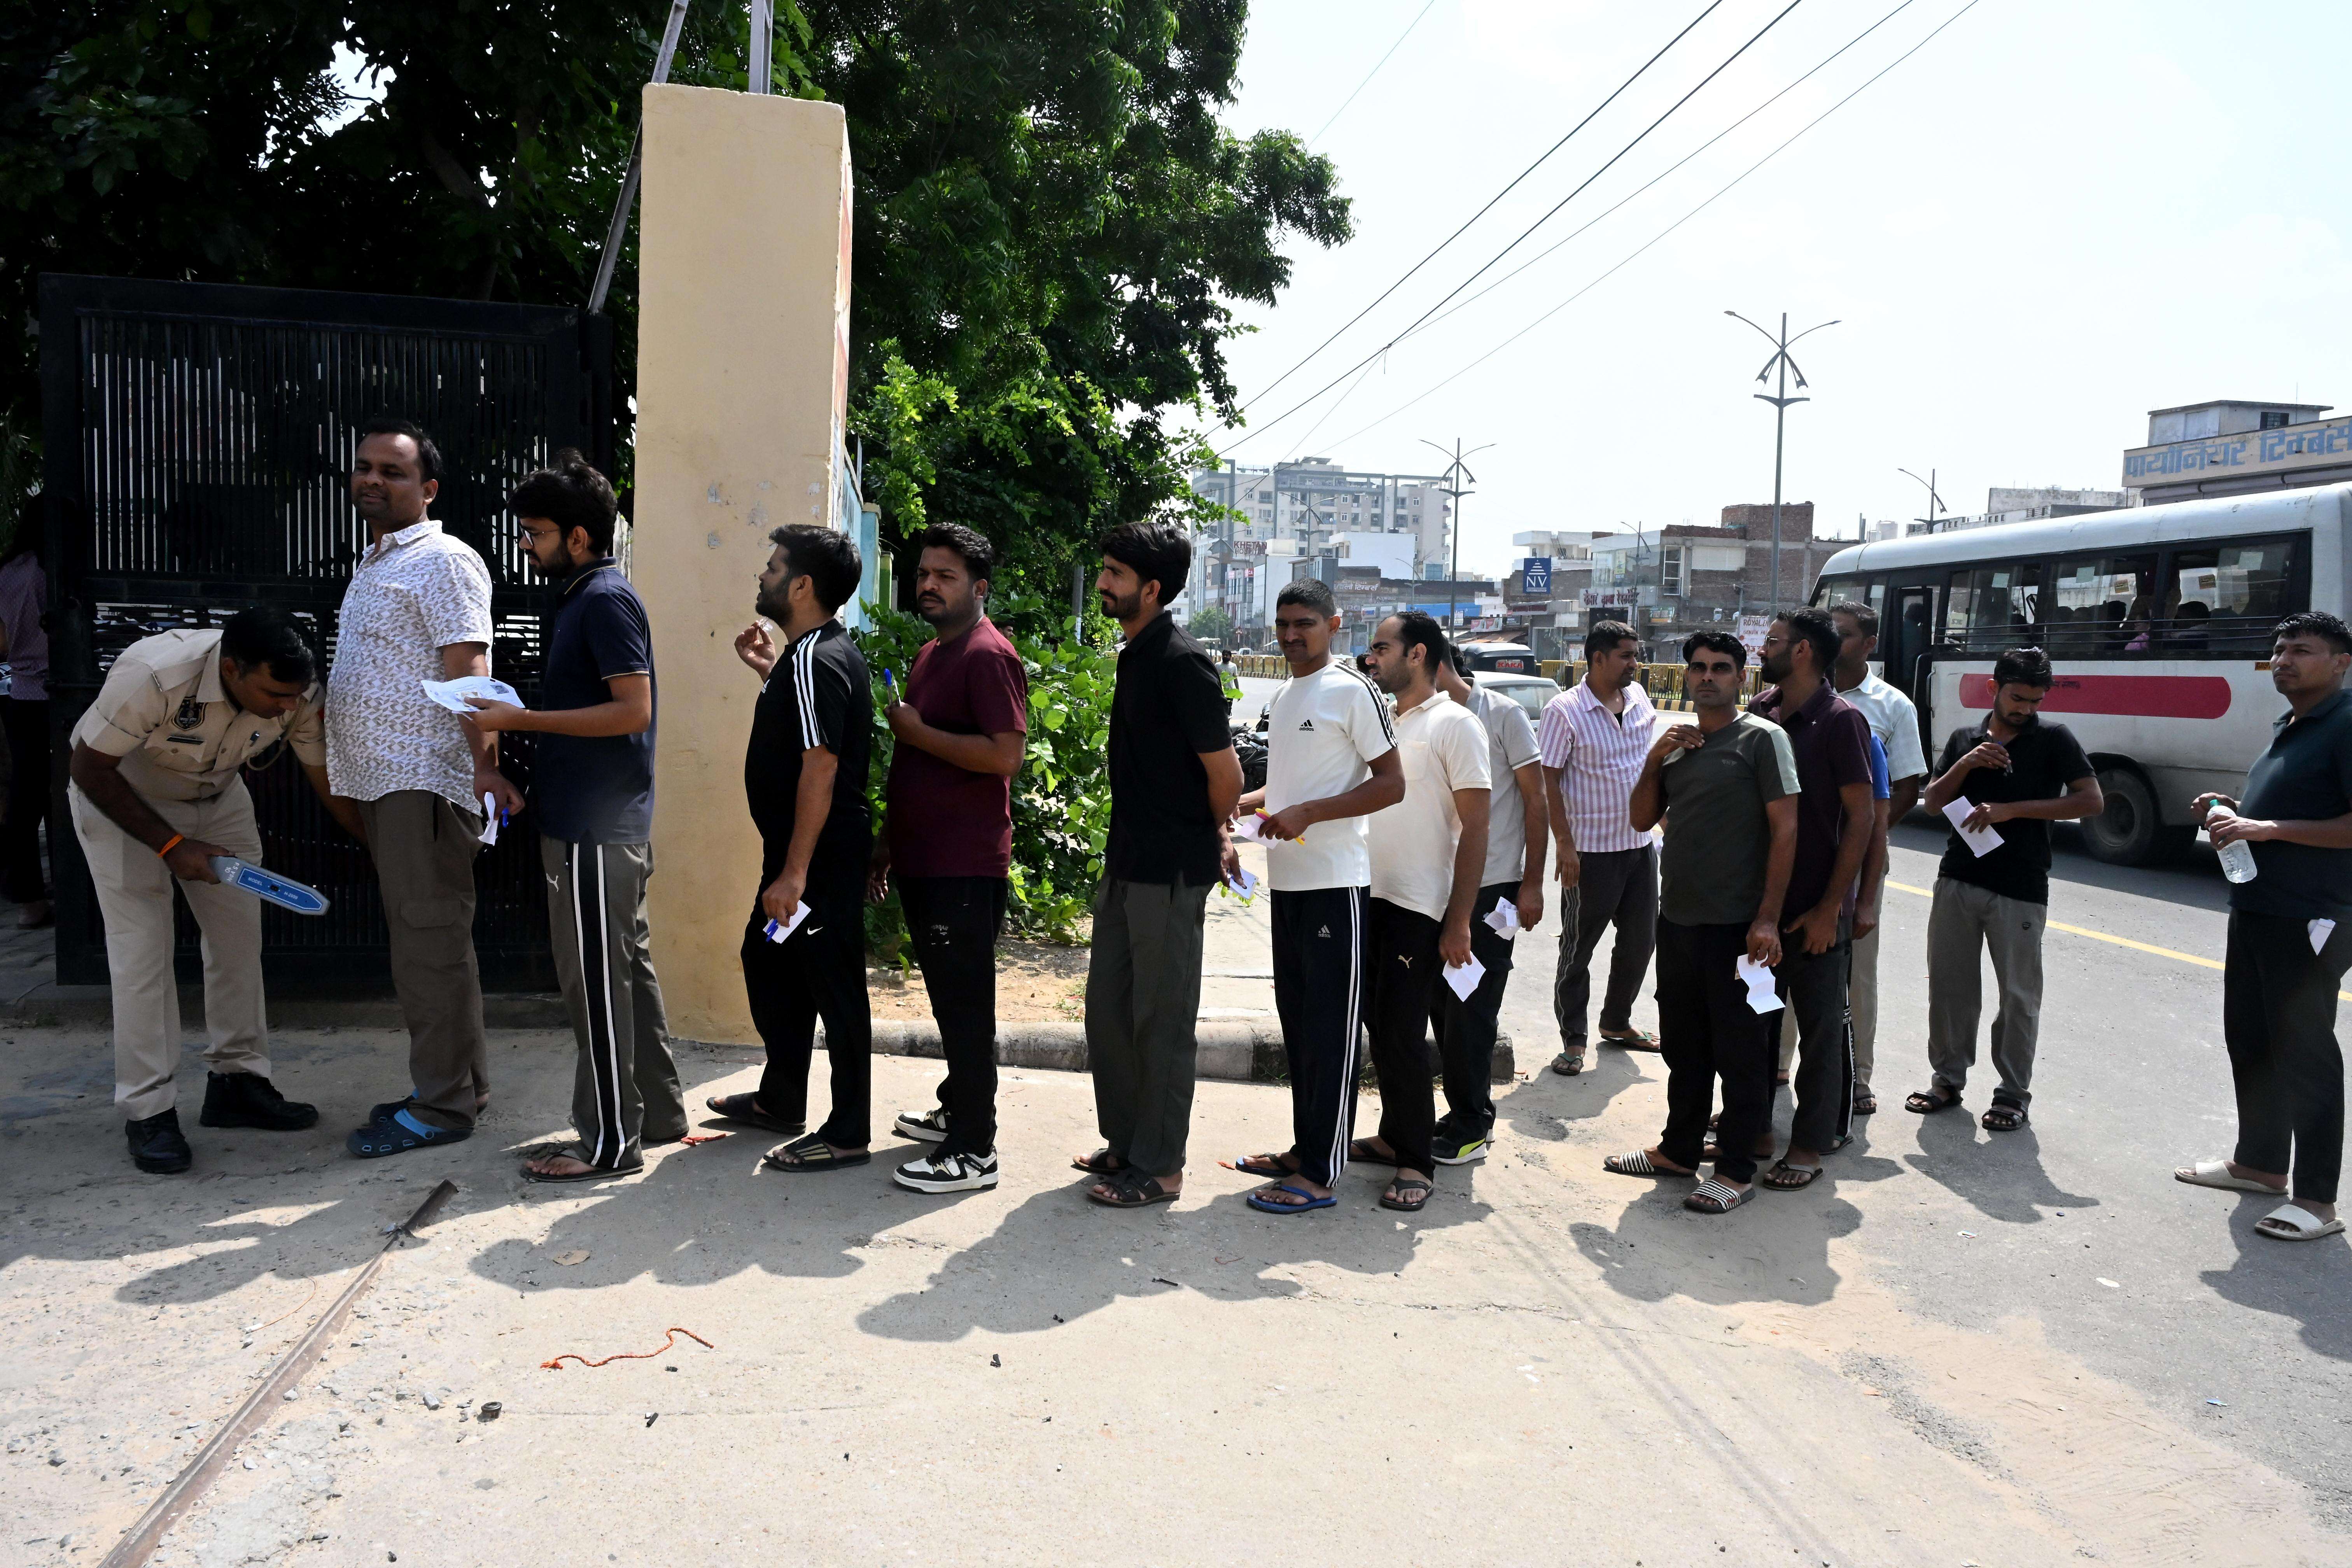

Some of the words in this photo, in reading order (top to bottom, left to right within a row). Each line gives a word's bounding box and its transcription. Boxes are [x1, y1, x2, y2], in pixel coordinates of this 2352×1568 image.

[1234, 541, 1267, 549] KHETAN
[1526, 576, 1547, 587] NV
[248, 877, 262, 886] MODEL
